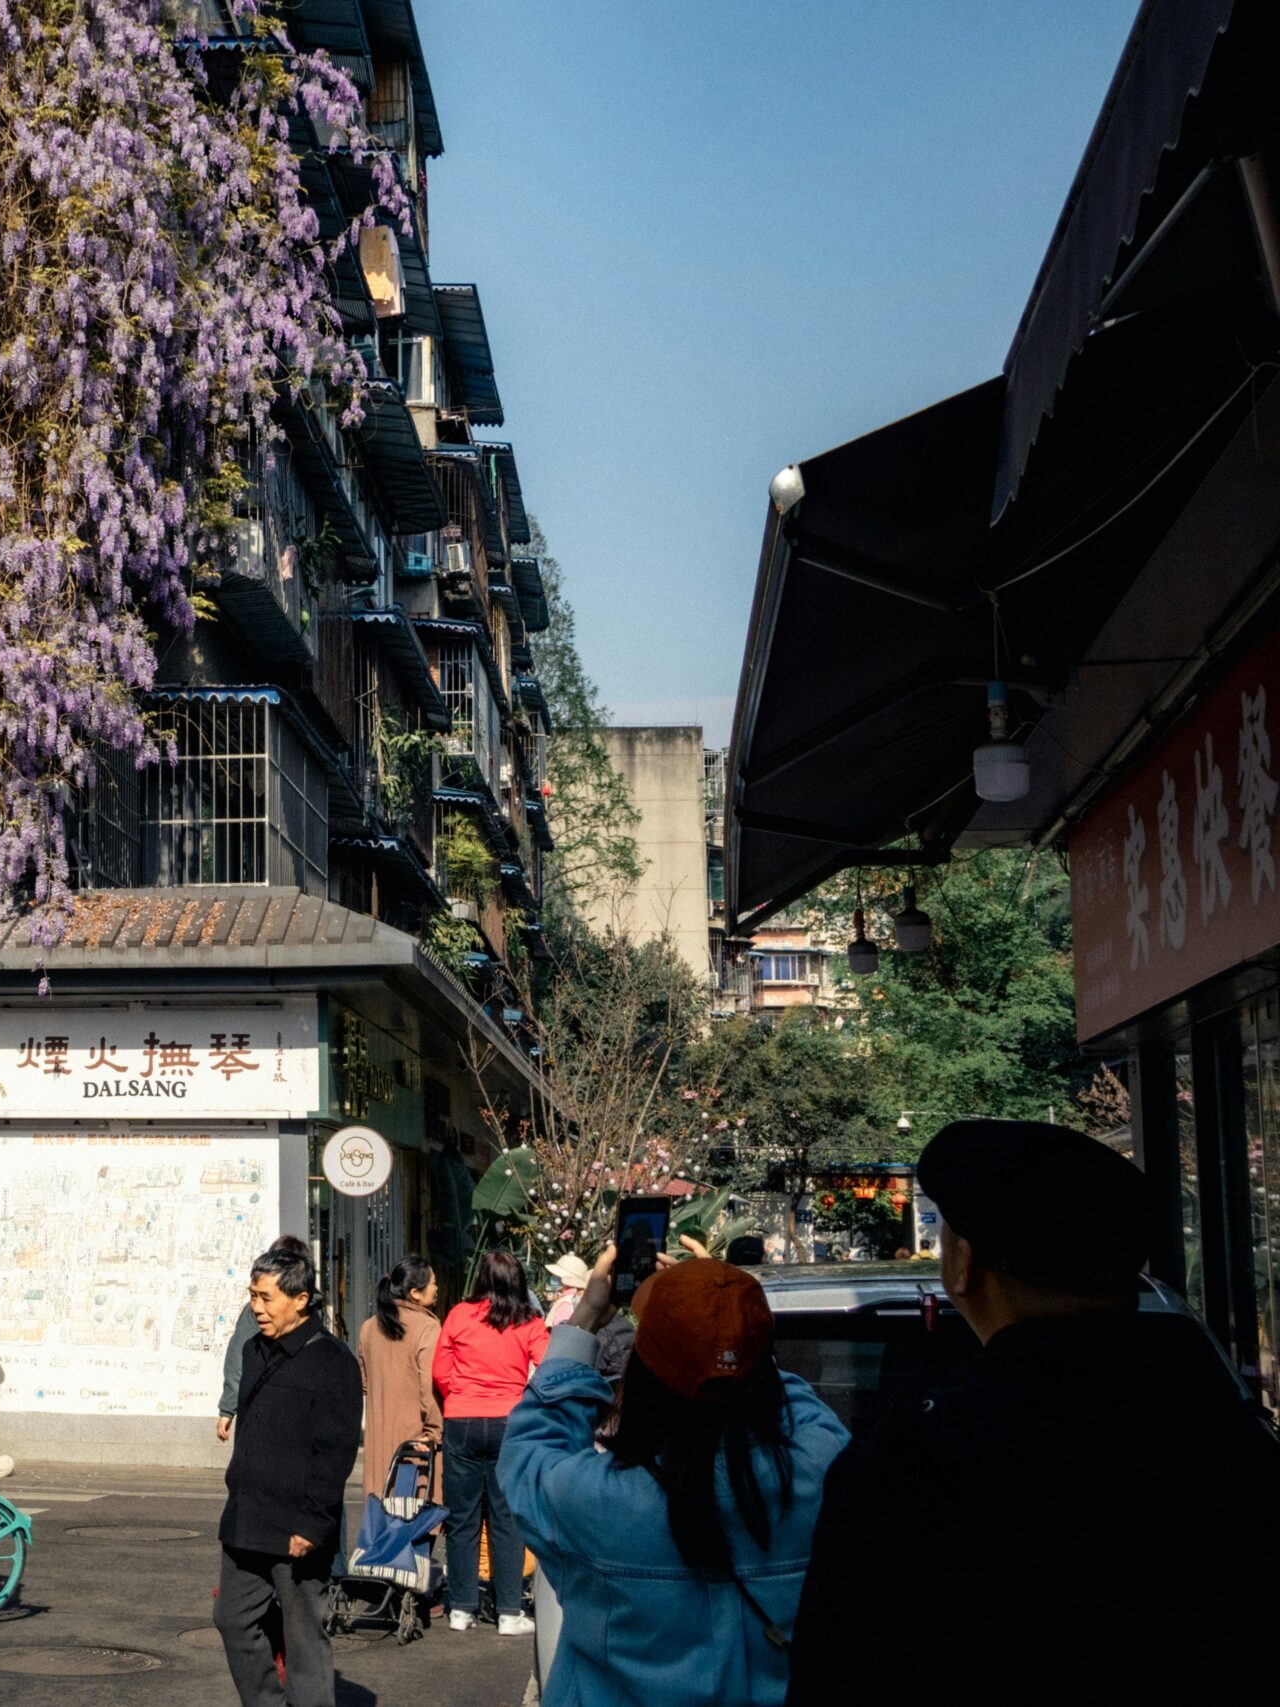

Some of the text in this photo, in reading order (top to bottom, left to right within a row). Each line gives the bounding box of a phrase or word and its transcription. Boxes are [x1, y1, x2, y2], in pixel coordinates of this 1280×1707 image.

[1123, 683, 1279, 973] 实惠快餐
[16, 1031, 260, 1081] 煙火撫琴
[83, 1080, 187, 1099] DALSANG
